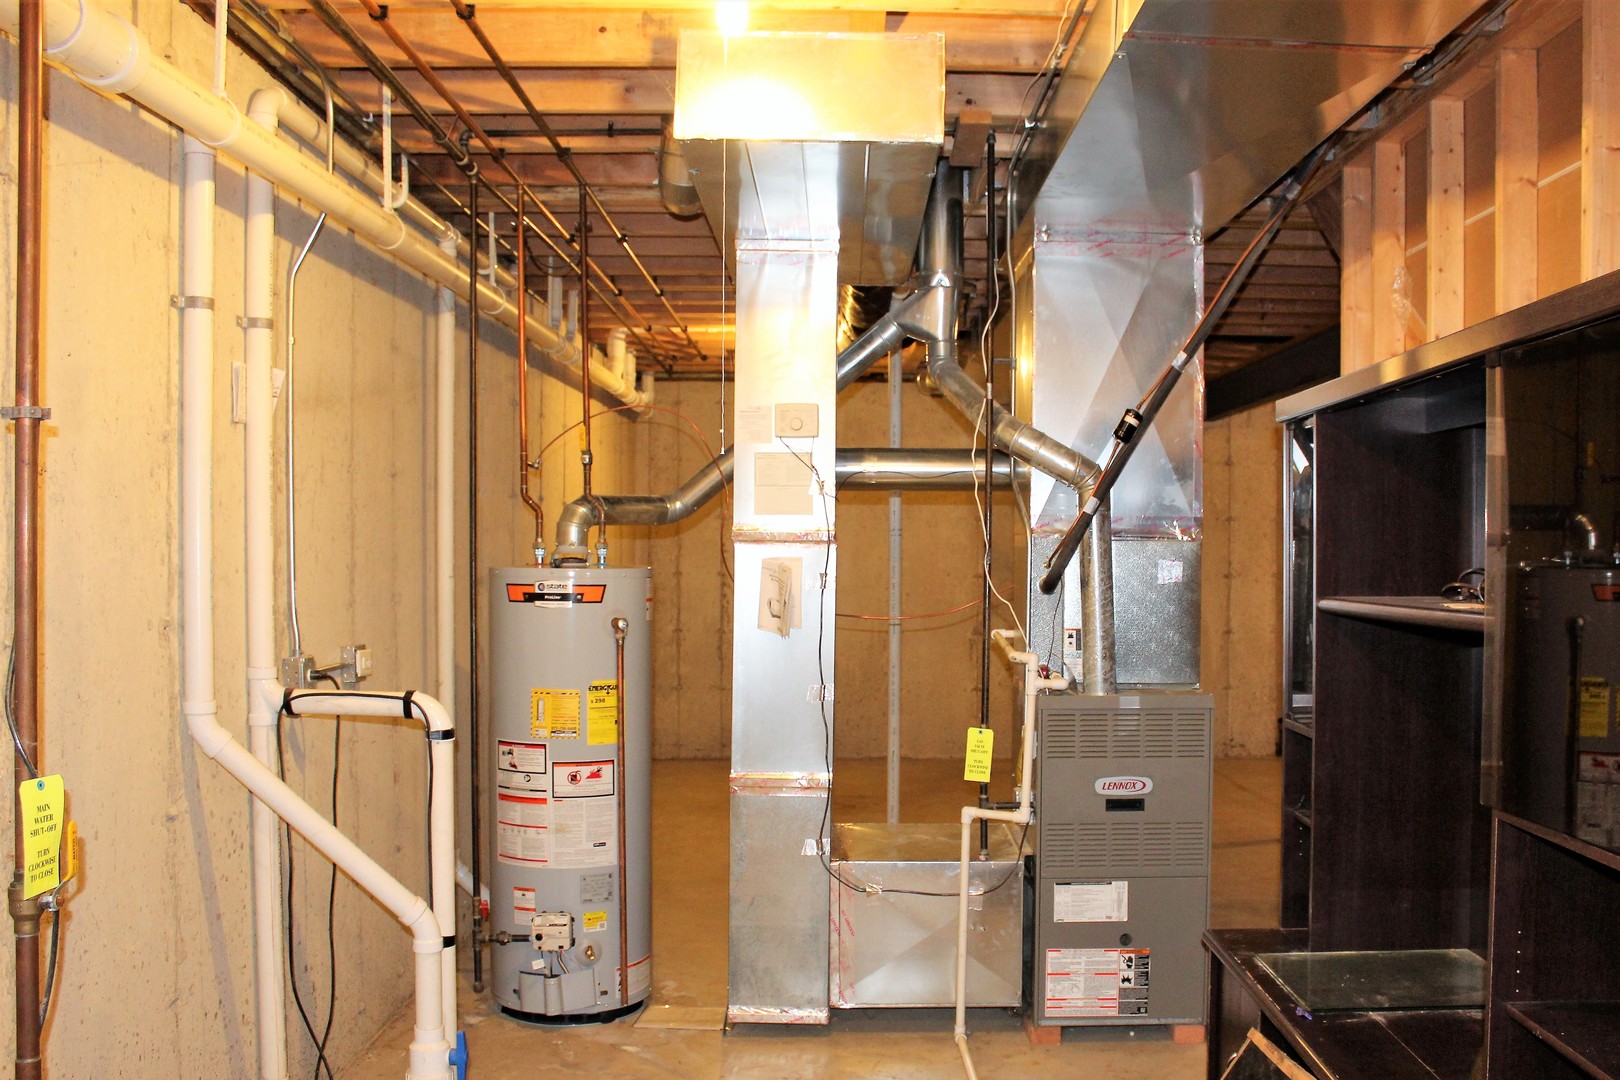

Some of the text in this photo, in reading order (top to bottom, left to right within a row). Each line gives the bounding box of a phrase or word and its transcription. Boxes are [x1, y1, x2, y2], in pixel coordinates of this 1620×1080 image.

[1102, 781, 1137, 790] LENNOX
[36, 803, 51, 813] MAIN
[34, 813, 54, 825] WATER
[30, 823, 57, 838] SHUT-OFF
[37, 847, 50, 858] TURN
[28, 855, 57, 872] CLOCKWISE
[30, 867, 54, 883] TO CLOSE
